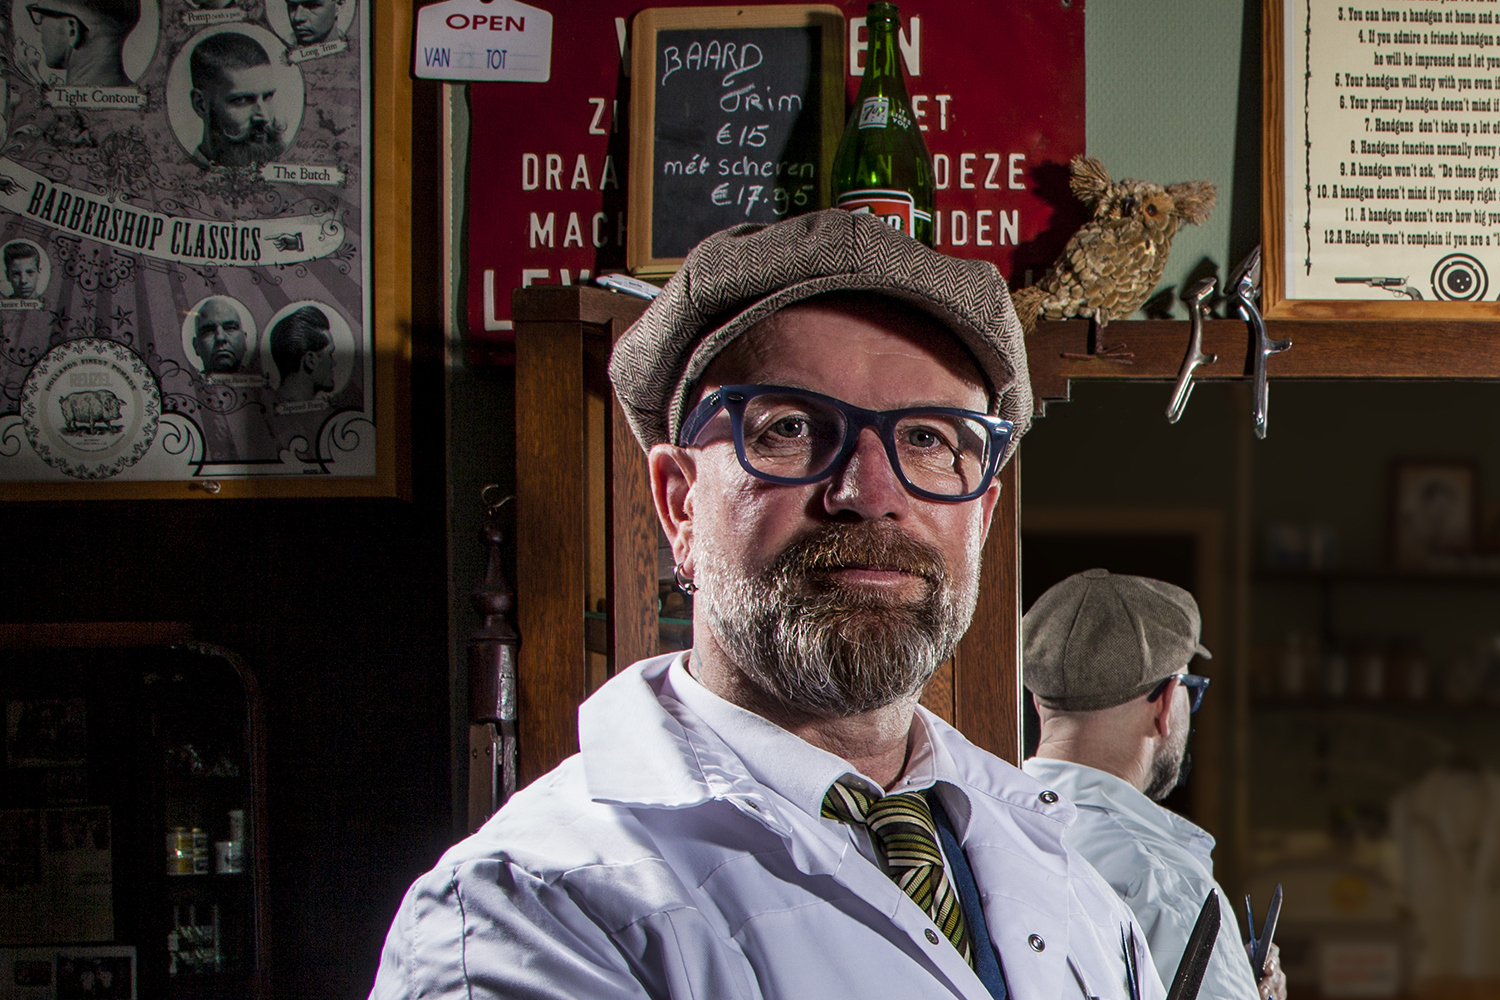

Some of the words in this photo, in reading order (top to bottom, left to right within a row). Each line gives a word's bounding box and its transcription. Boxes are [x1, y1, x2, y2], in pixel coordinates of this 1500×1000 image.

[188, 12, 211, 24] Pomp
[445, 13, 526, 33] OPEN
[1338, 6, 1346, 21] 3.
[1348, 6, 1363, 22] You
[1365, 10, 1379, 22] can
[1381, 7, 1400, 22] have
[1402, 11, 1407, 22] a
[1409, 8, 1443, 26] handgun
[1445, 10, 1453, 23] at
[1455, 9, 1476, 24] home
[1478, 10, 1493, 25] and
[300, 47, 319, 58] Long
[320, 43, 338, 54] Trim
[423, 47, 451, 68] VAN
[486, 48, 508, 70] TOT
[658, 42, 764, 88] BAARD
[55, 89, 89, 106] Tight
[91, 90, 141, 105] Contour
[1339, 95, 1347, 110] 6.
[1350, 95, 1369, 110] Your
[1371, 96, 1403, 114] primary
[1405, 96, 1439, 114] handgun
[1441, 97, 1469, 112] doesn't
[1472, 98, 1491, 112] mind
[1493, 98, 1499, 112] if
[716, 122, 770, 148] €15
[274, 166, 296, 181] The
[299, 167, 331, 182] Butch
[716, 152, 815, 180] scheren
[26, 181, 164, 252] BARBERSHOP
[172, 220, 263, 262] CLASSICS
[1345, 207, 1357, 222] 11.
[1360, 207, 1366, 222] A
[1368, 207, 1402, 225] handgun
[1404, 208, 1433, 223] doesn't
[1435, 211, 1453, 223] care
[1455, 209, 1472, 224] how
[1474, 209, 1486, 227] big
